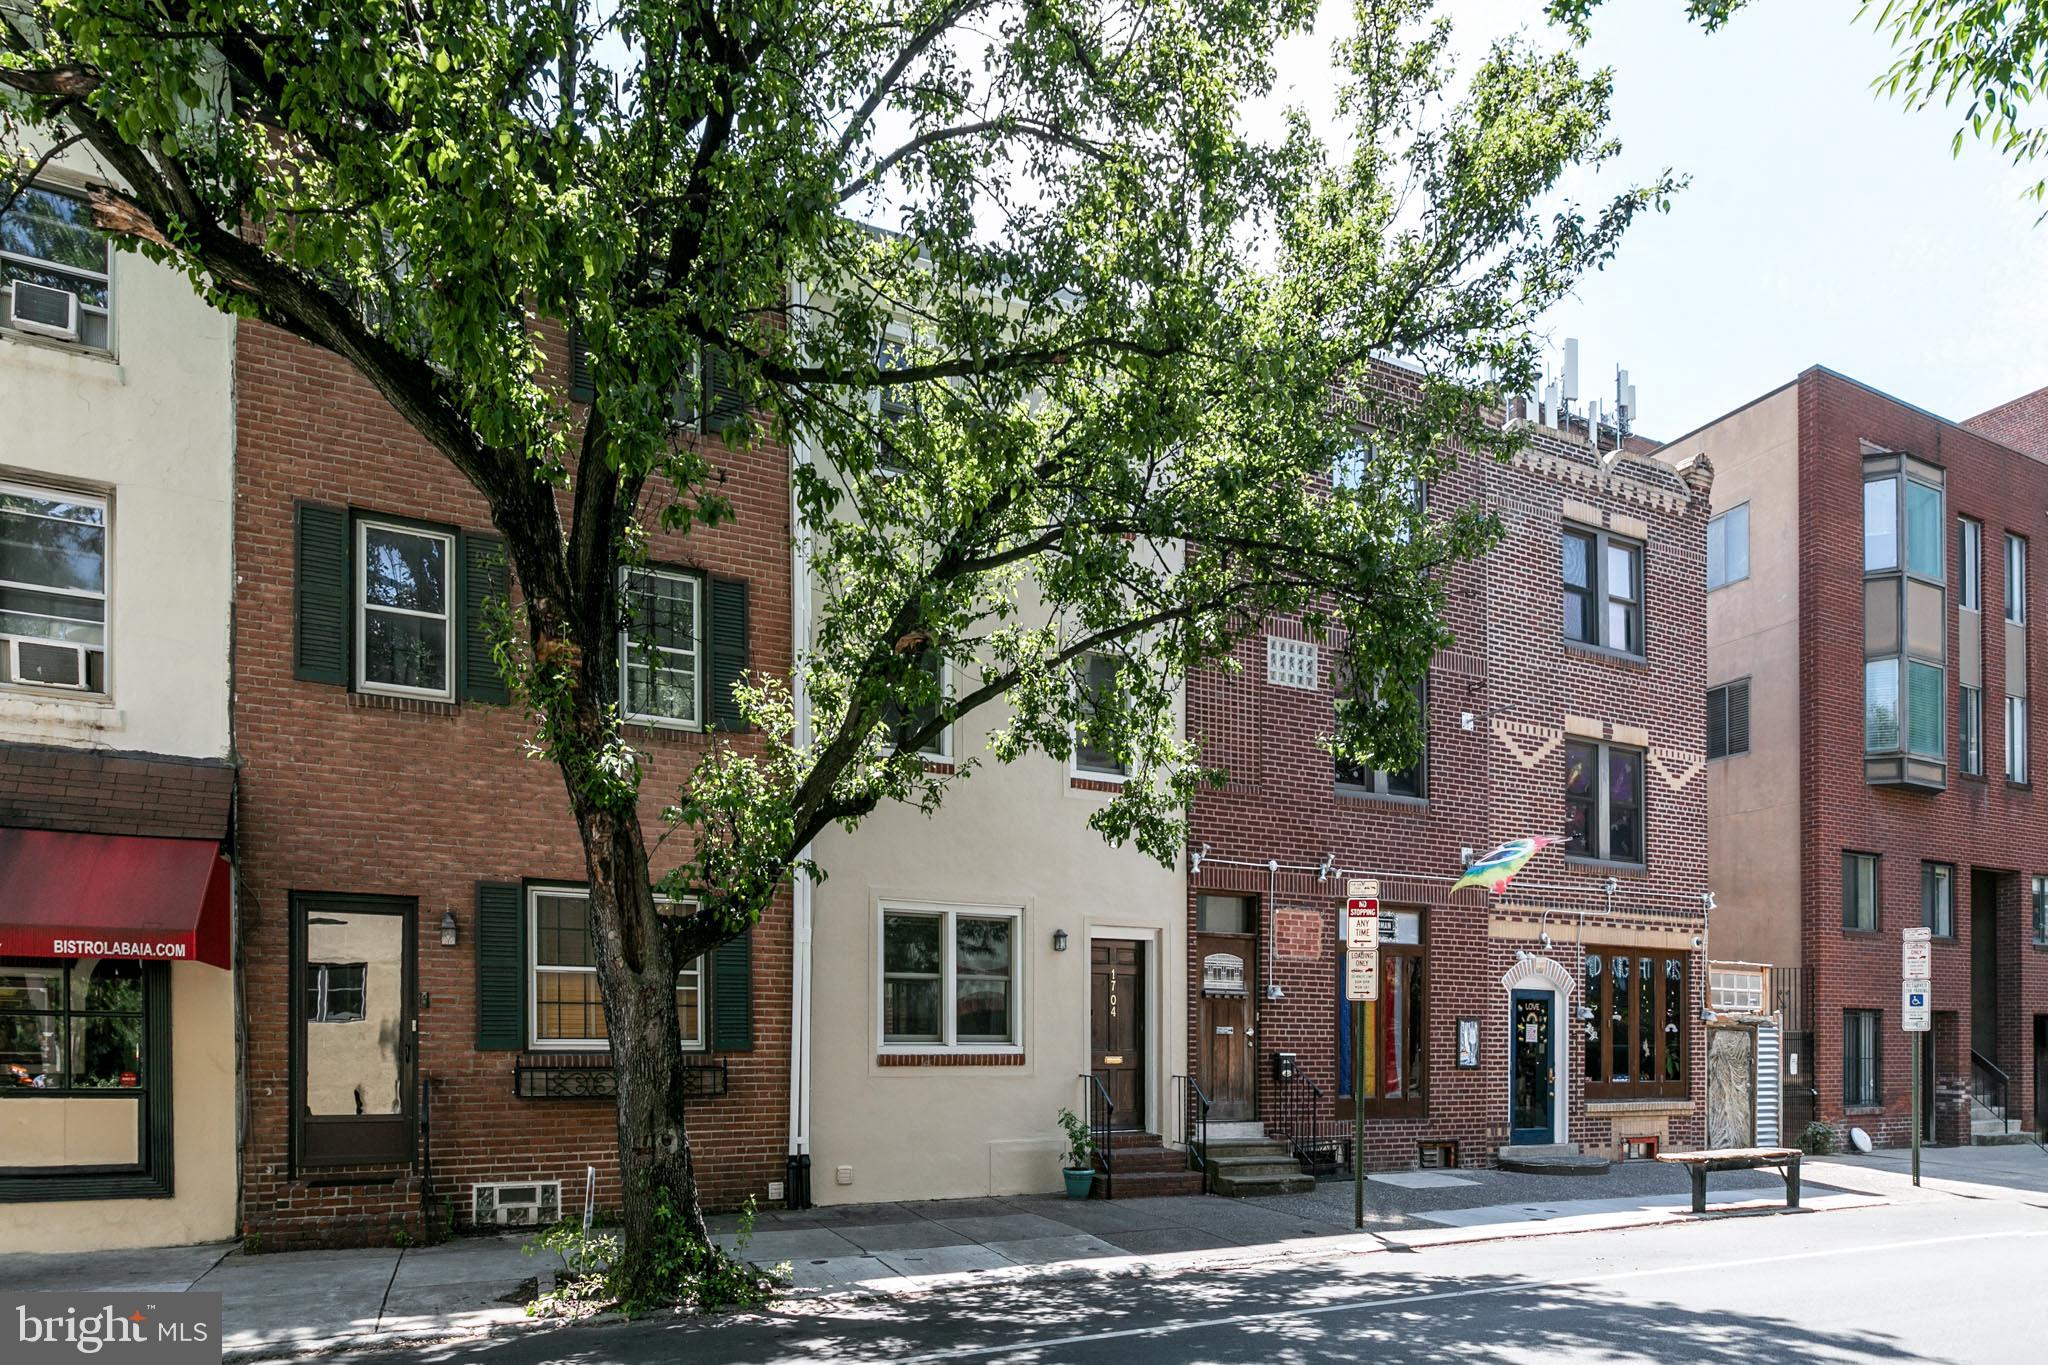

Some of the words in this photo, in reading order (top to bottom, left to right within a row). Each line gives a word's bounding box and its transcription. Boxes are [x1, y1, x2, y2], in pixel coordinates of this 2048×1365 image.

[1358, 900, 1367, 908] NO
[1356, 919, 1370, 927] ANY
[1356, 928, 1370, 937] TIME
[53, 939, 186, 957] BISTROLABAIA.COM
[1524, 1002, 1541, 1011] LOVE
